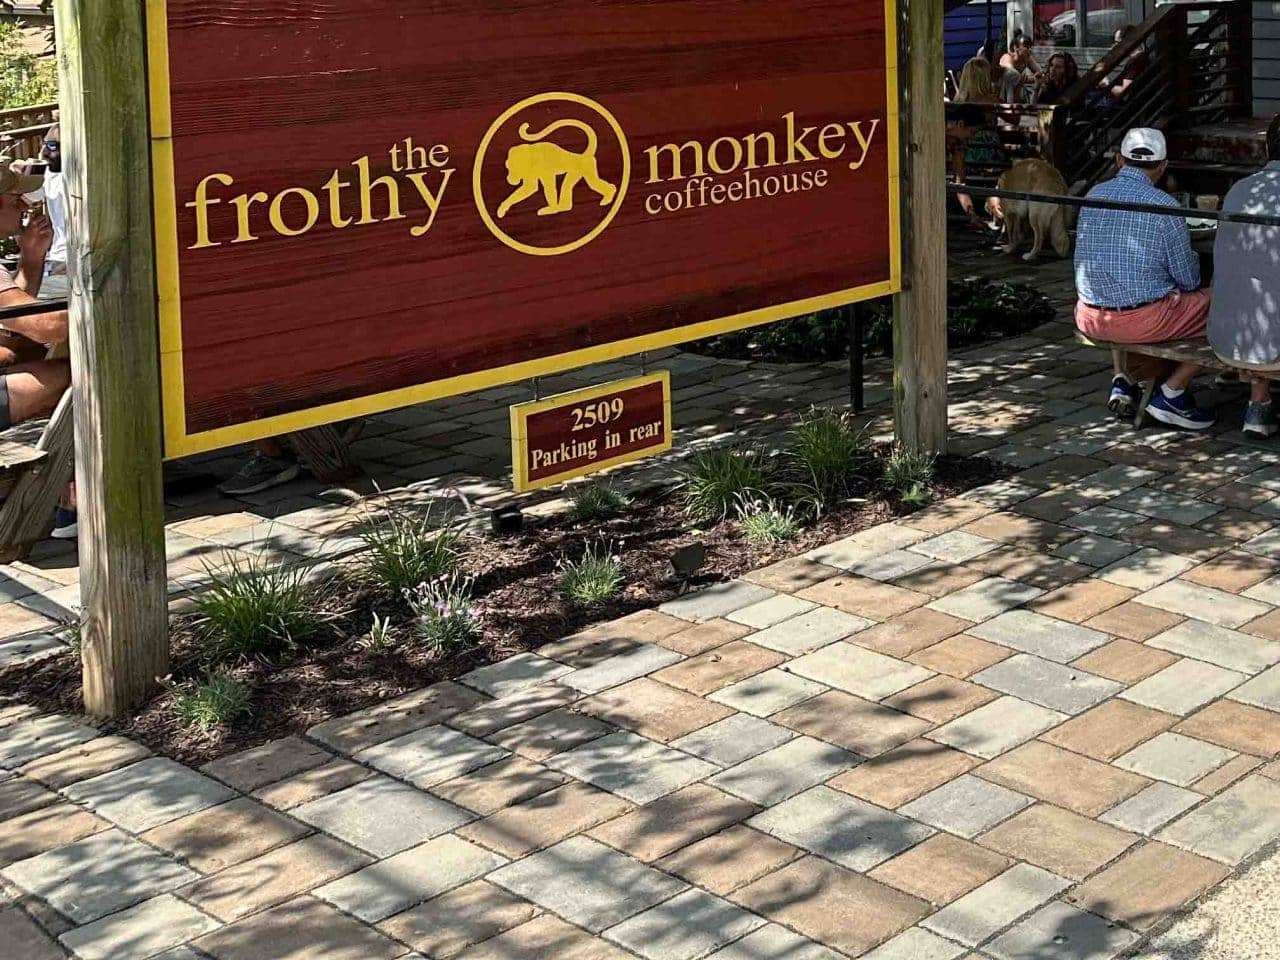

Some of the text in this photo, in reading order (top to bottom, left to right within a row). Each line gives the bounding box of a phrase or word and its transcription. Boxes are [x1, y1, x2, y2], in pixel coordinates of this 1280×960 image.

[388, 136, 450, 172] the
[185, 111, 881, 250] frothy monkey
[645, 168, 829, 215] coffeehouse
[571, 397, 624, 432] 2509
[530, 420, 662, 471] Parking in rear
